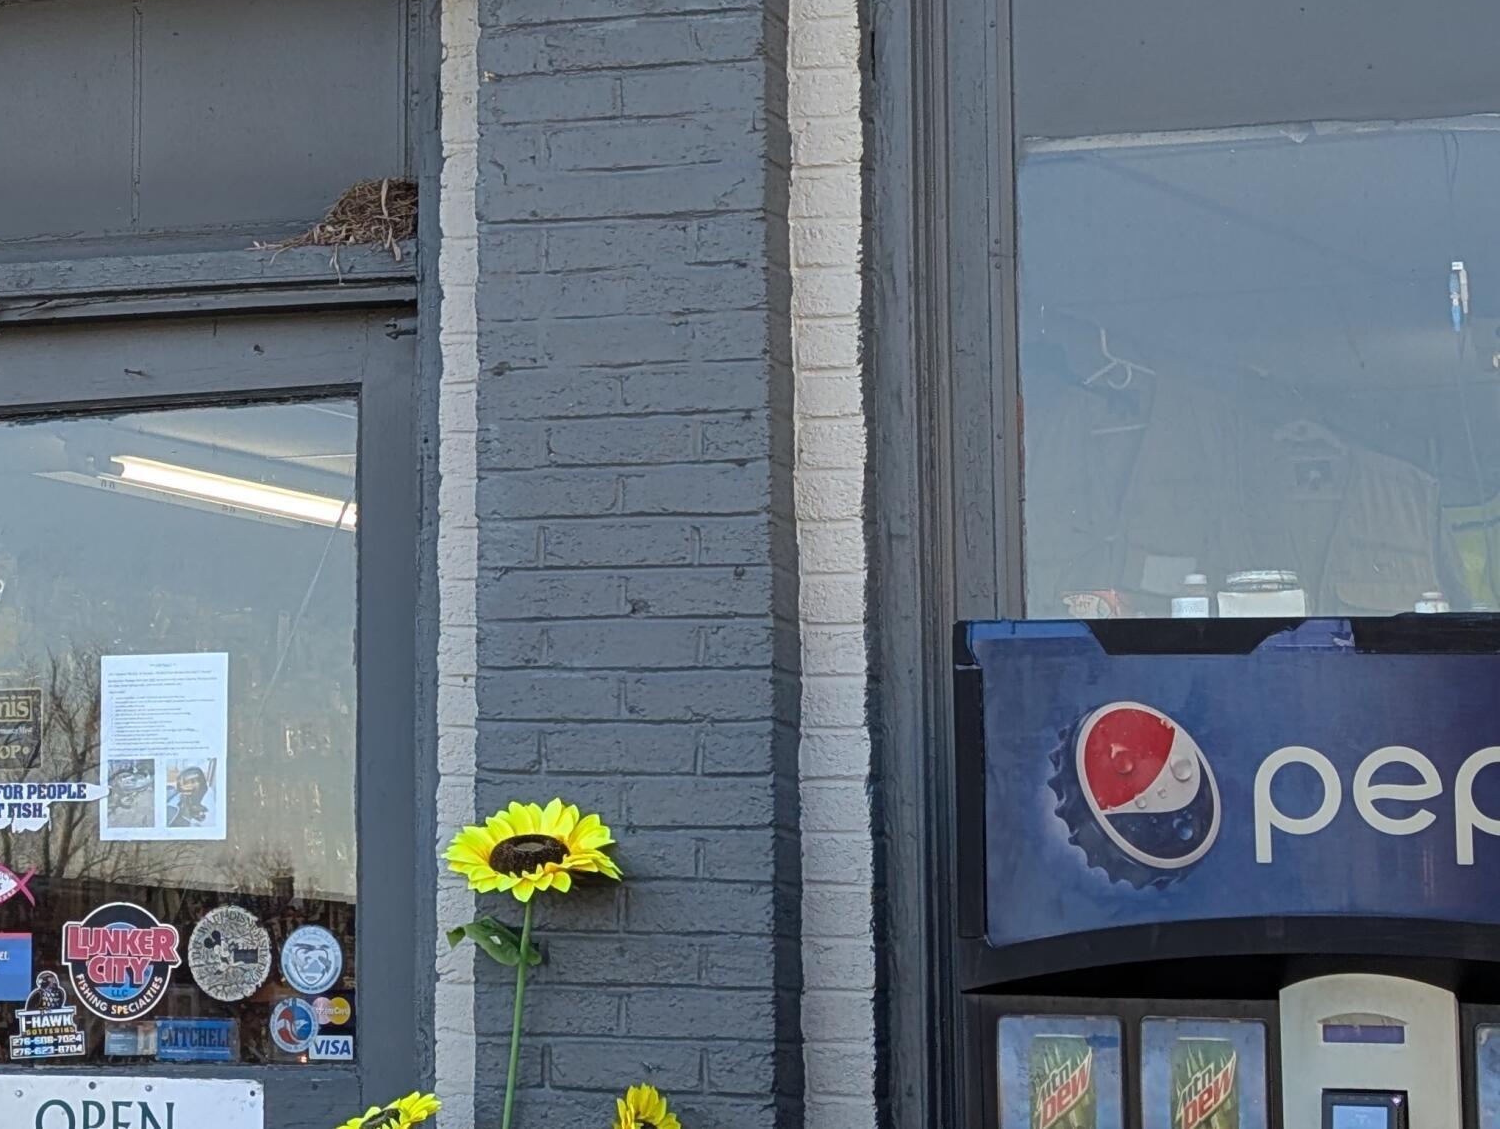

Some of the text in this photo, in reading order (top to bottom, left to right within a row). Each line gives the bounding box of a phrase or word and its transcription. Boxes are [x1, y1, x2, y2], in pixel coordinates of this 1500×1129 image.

[27, 784, 86, 800] PEOPLE
[67, 925, 178, 962] LUNKER
[87, 956, 151, 985] CITY
[76, 973, 164, 1015] FISHING SPECIALTIES
[111, 989, 129, 997] LLC
[314, 1039, 350, 1056] VISA
[35, 1099, 175, 1129] OPEN
